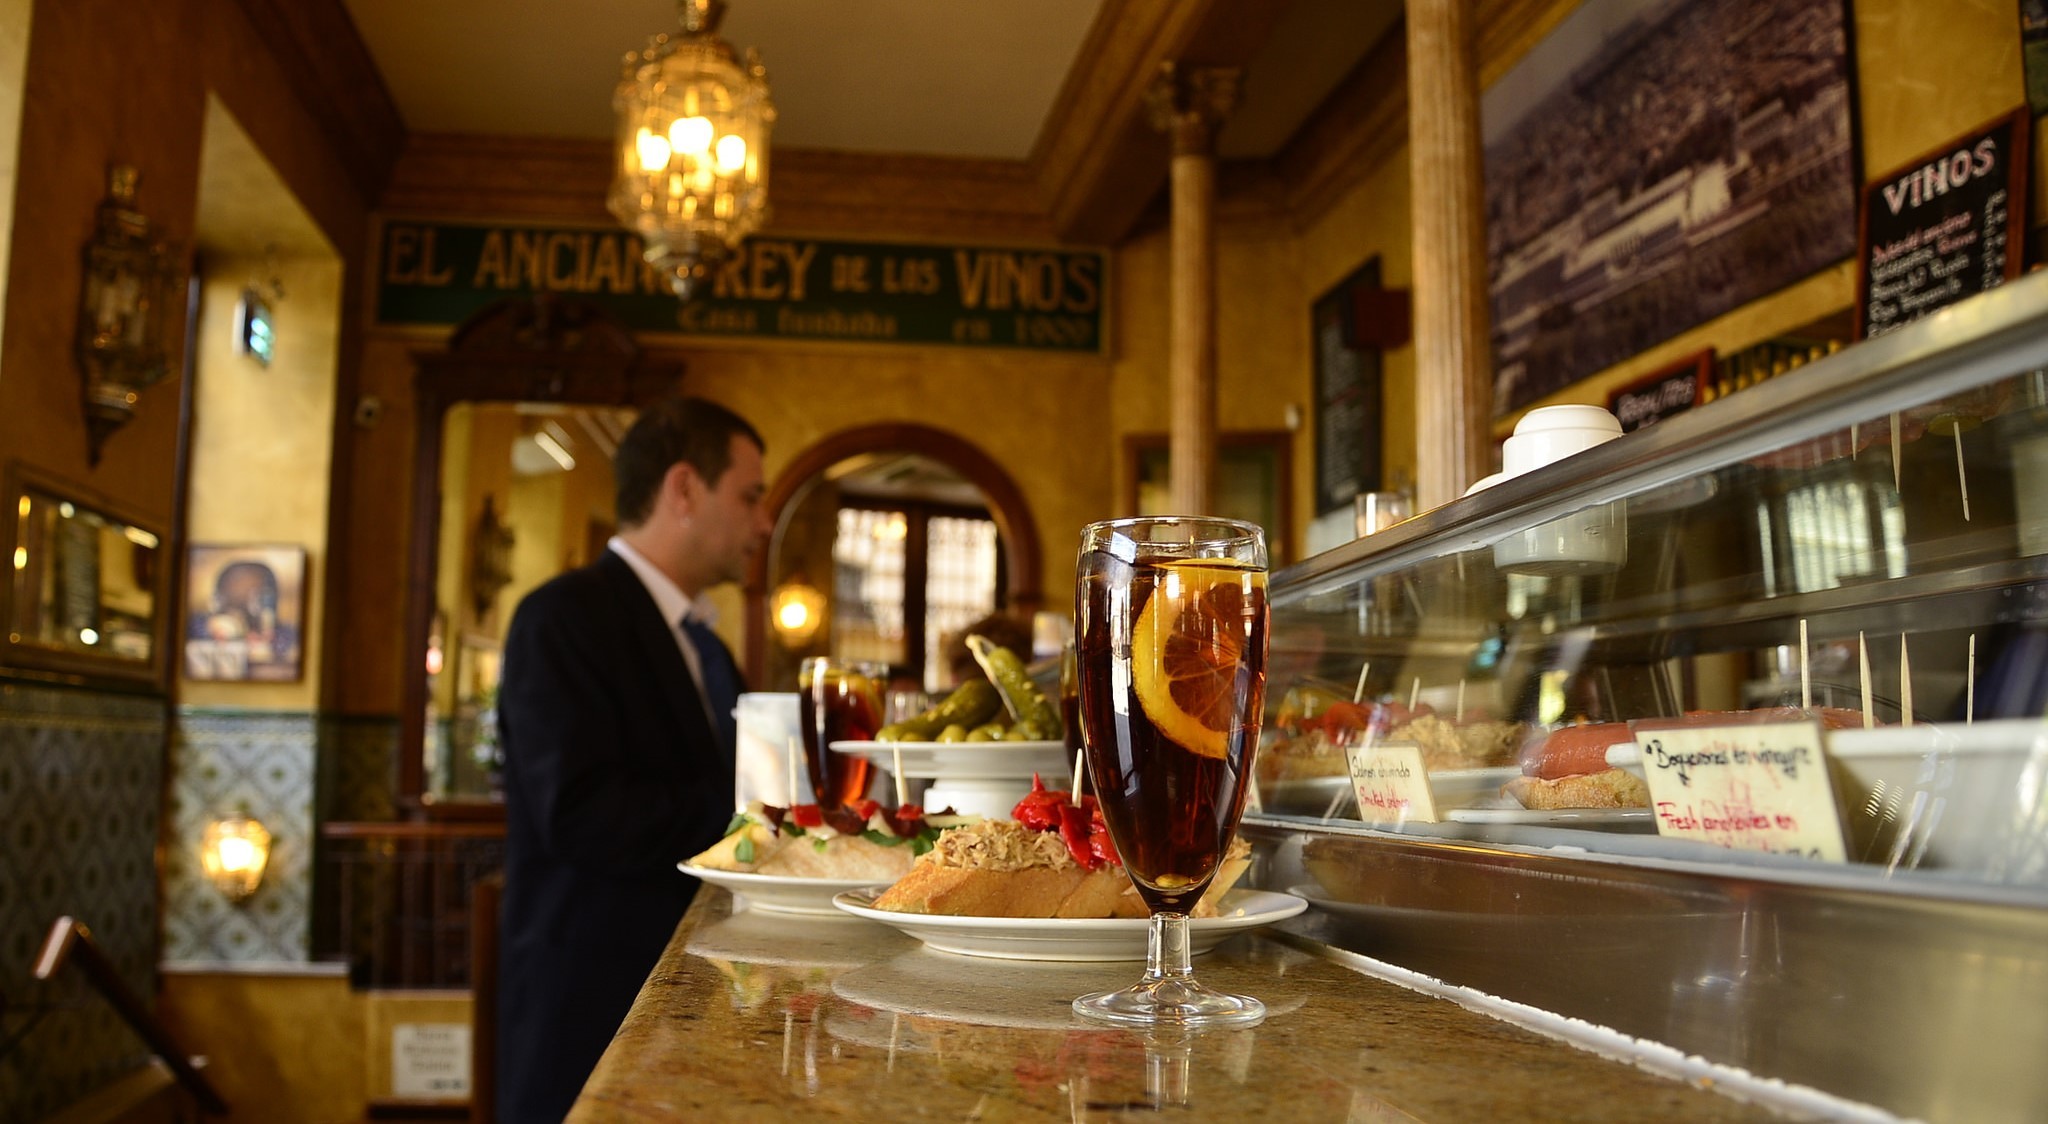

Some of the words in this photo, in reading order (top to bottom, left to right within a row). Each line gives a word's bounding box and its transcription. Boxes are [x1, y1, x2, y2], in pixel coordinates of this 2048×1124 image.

[1881, 135, 1997, 216] VINOS
[385, 226, 456, 288] EL
[471, 229, 685, 297] ANCIAN
[712, 238, 818, 301] REY
[830, 253, 873, 293] DE
[881, 254, 941, 296] LOS
[952, 247, 1098, 313] VINOS
[1656, 801, 1700, 831] Fresh
